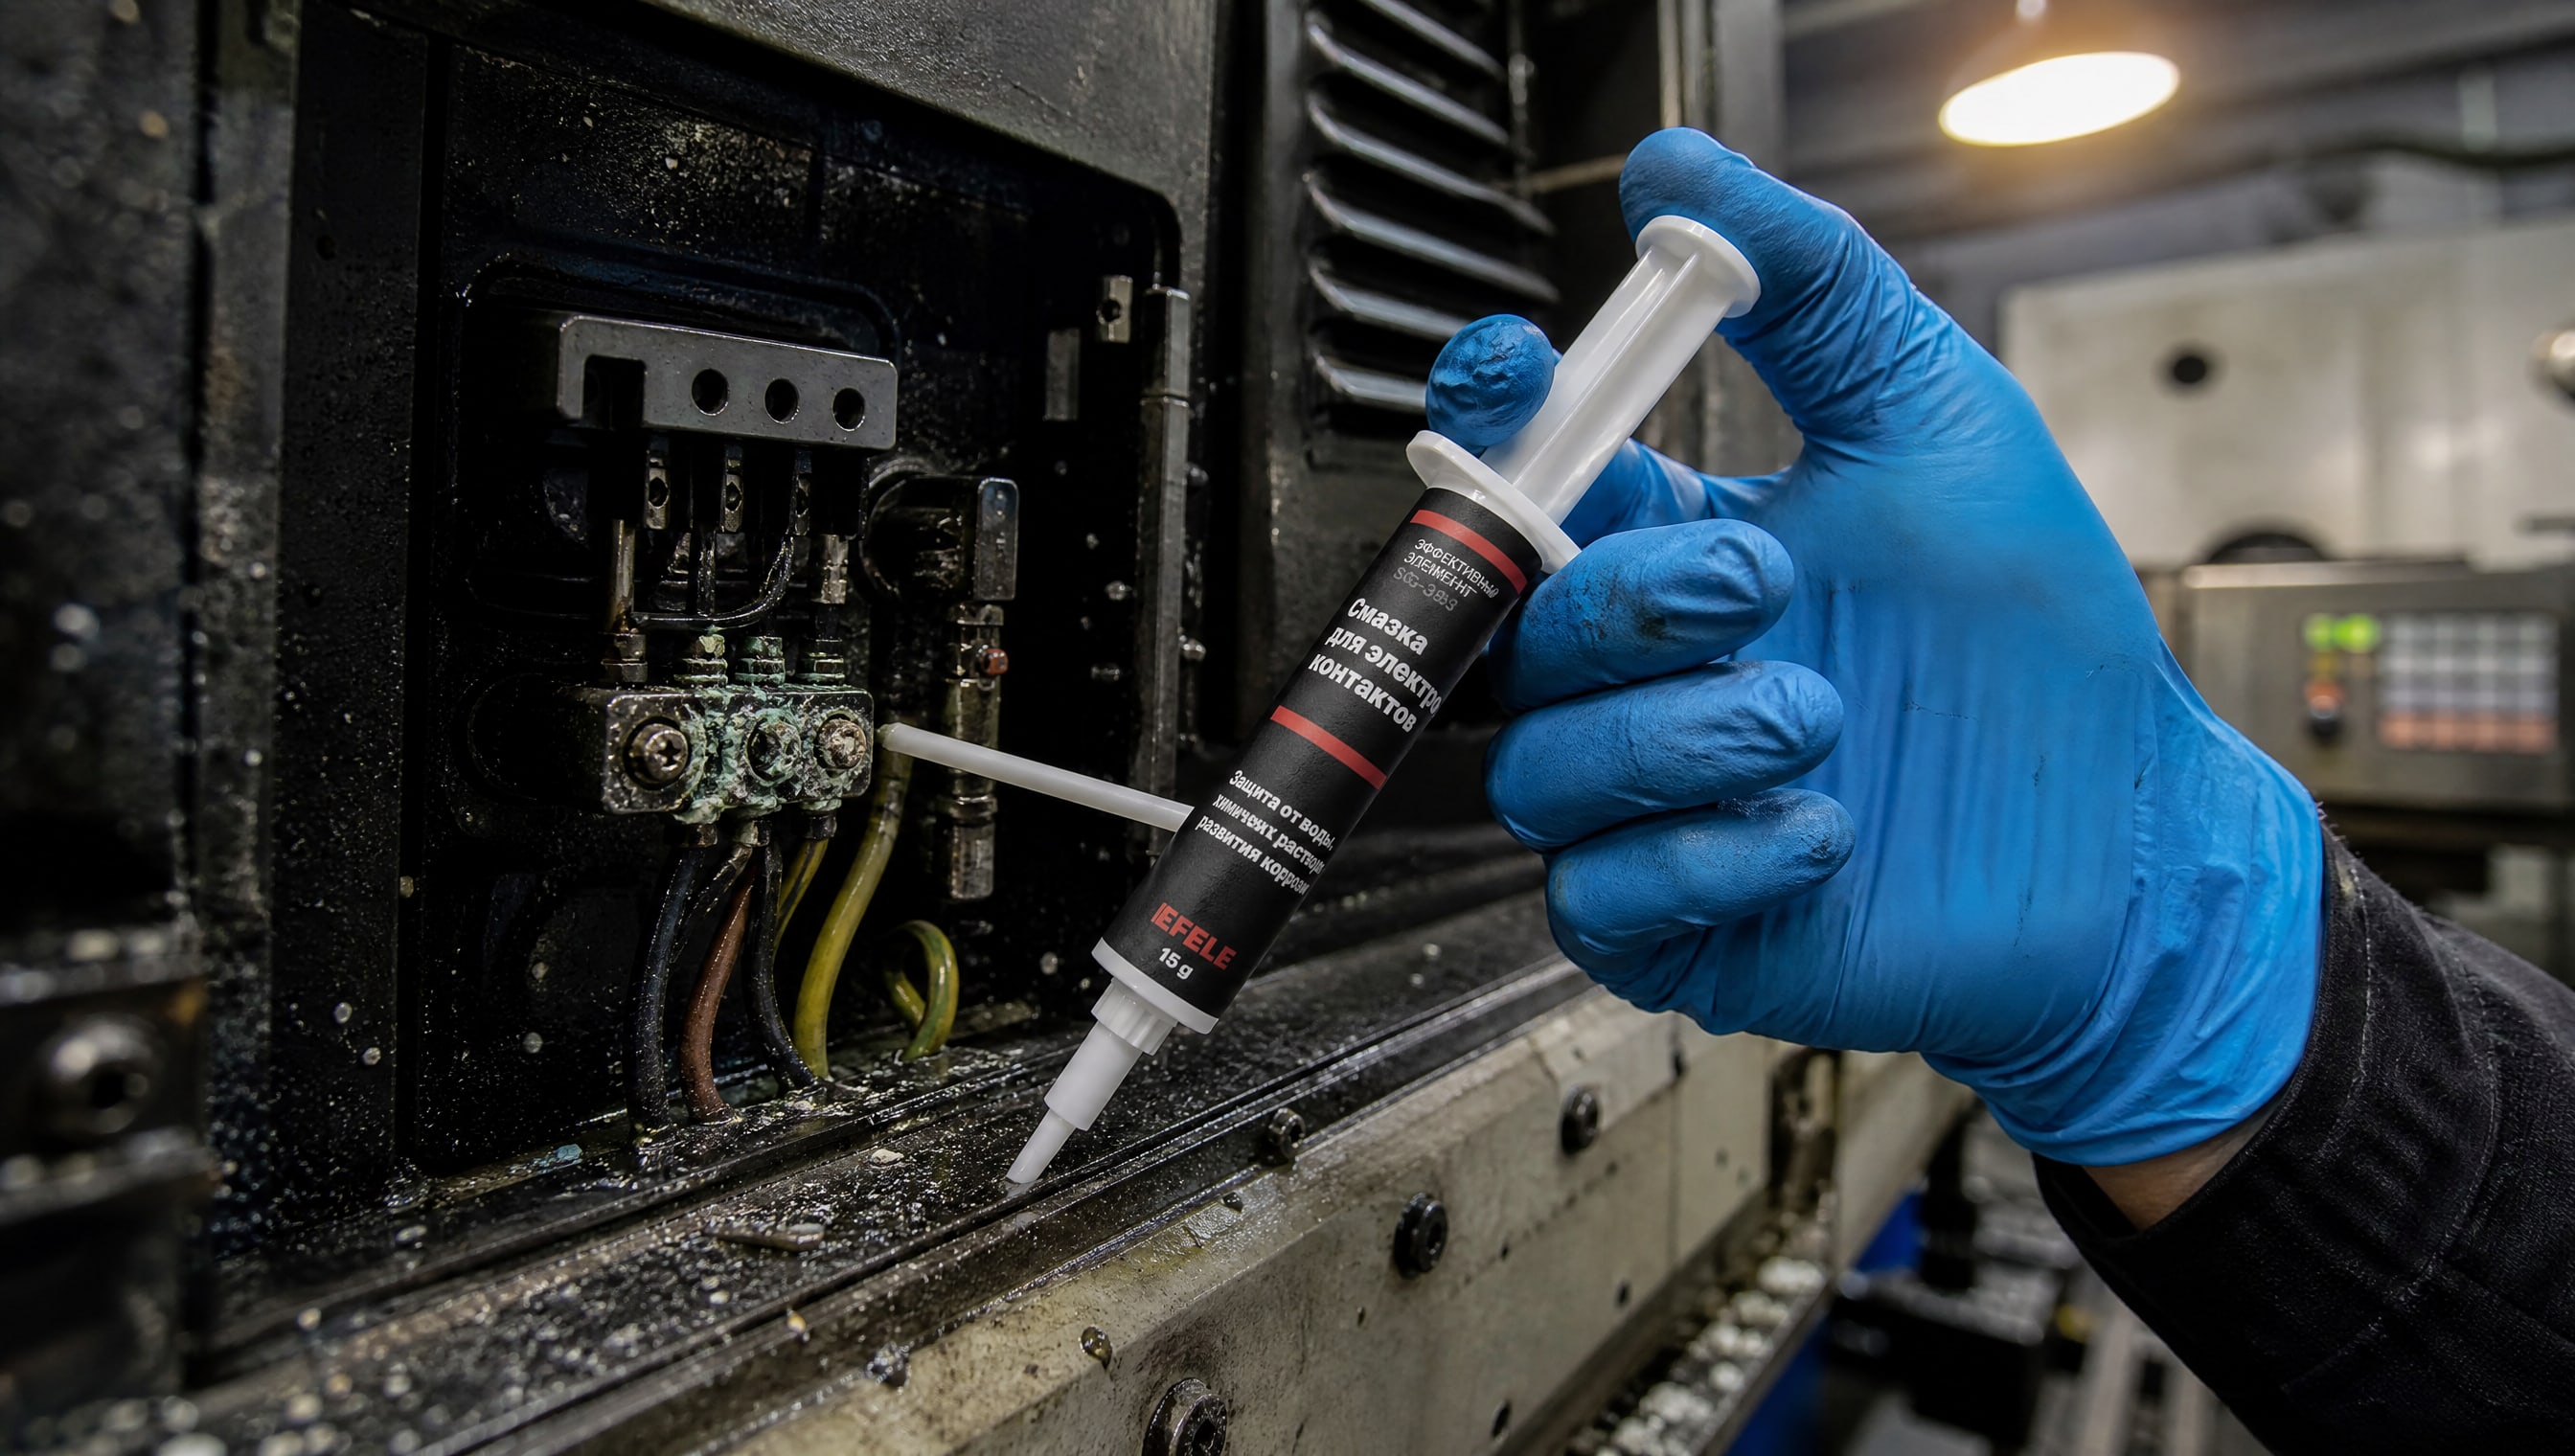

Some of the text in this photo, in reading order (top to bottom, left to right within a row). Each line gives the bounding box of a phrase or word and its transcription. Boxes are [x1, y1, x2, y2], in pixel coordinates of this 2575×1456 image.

[1347, 598, 1428, 656] Смазка
[1308, 653, 1418, 733] контактов
[1324, 626, 1443, 715] для электро
[1195, 815, 1264, 863] развития
[1229, 769, 1336, 852] Защита от воды,
[1158, 947, 1194, 980] 15 g
